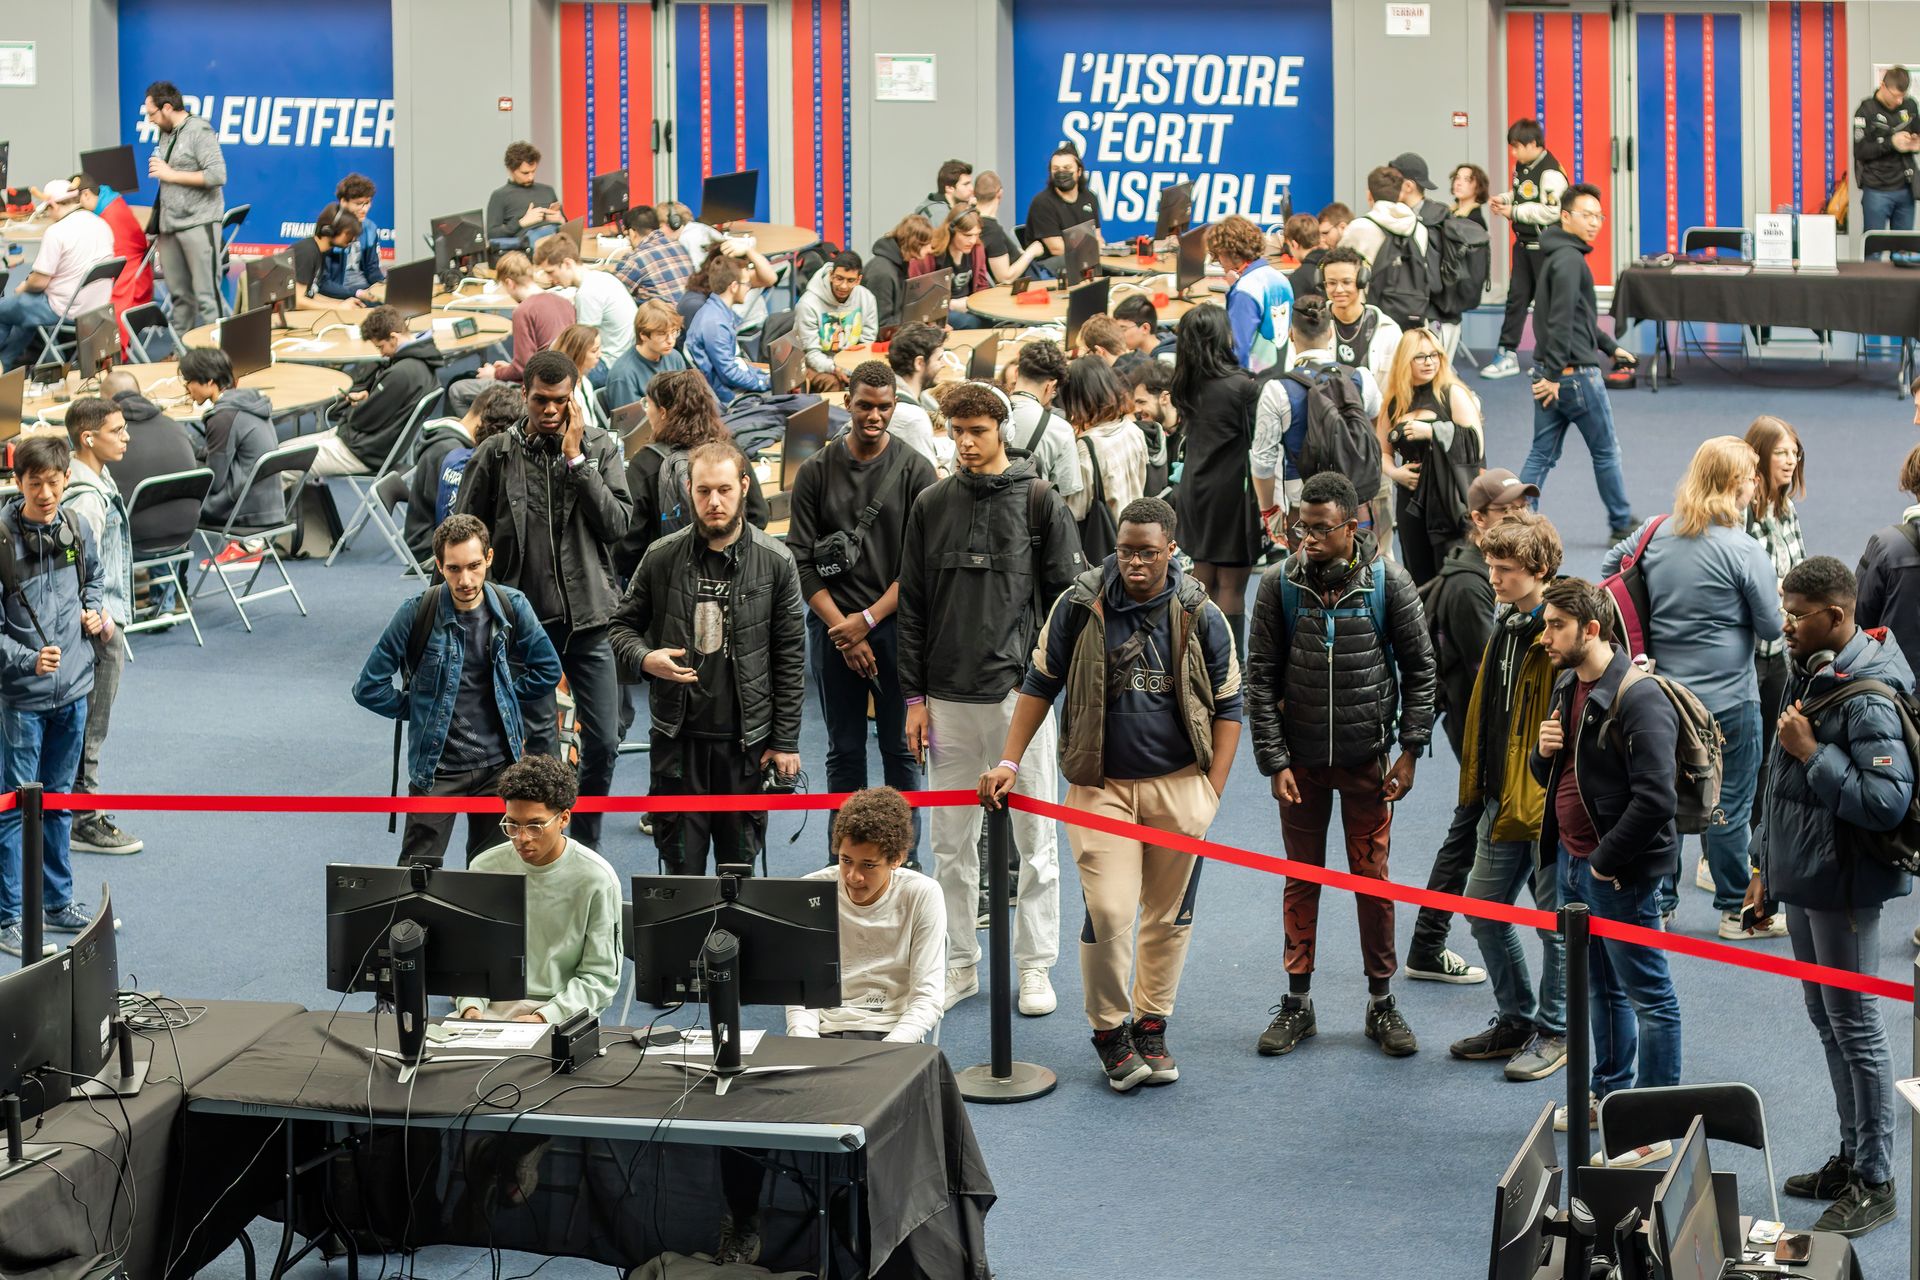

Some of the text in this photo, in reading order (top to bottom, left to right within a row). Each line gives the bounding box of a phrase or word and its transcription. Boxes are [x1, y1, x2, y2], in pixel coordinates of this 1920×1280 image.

[1057, 52, 1305, 106] L'HISTOIRE
[1058, 102, 1235, 165] S'ÉCRIT
[1086, 170, 1292, 225] NSEMBLE
[865, 996, 887, 1006] WAY
